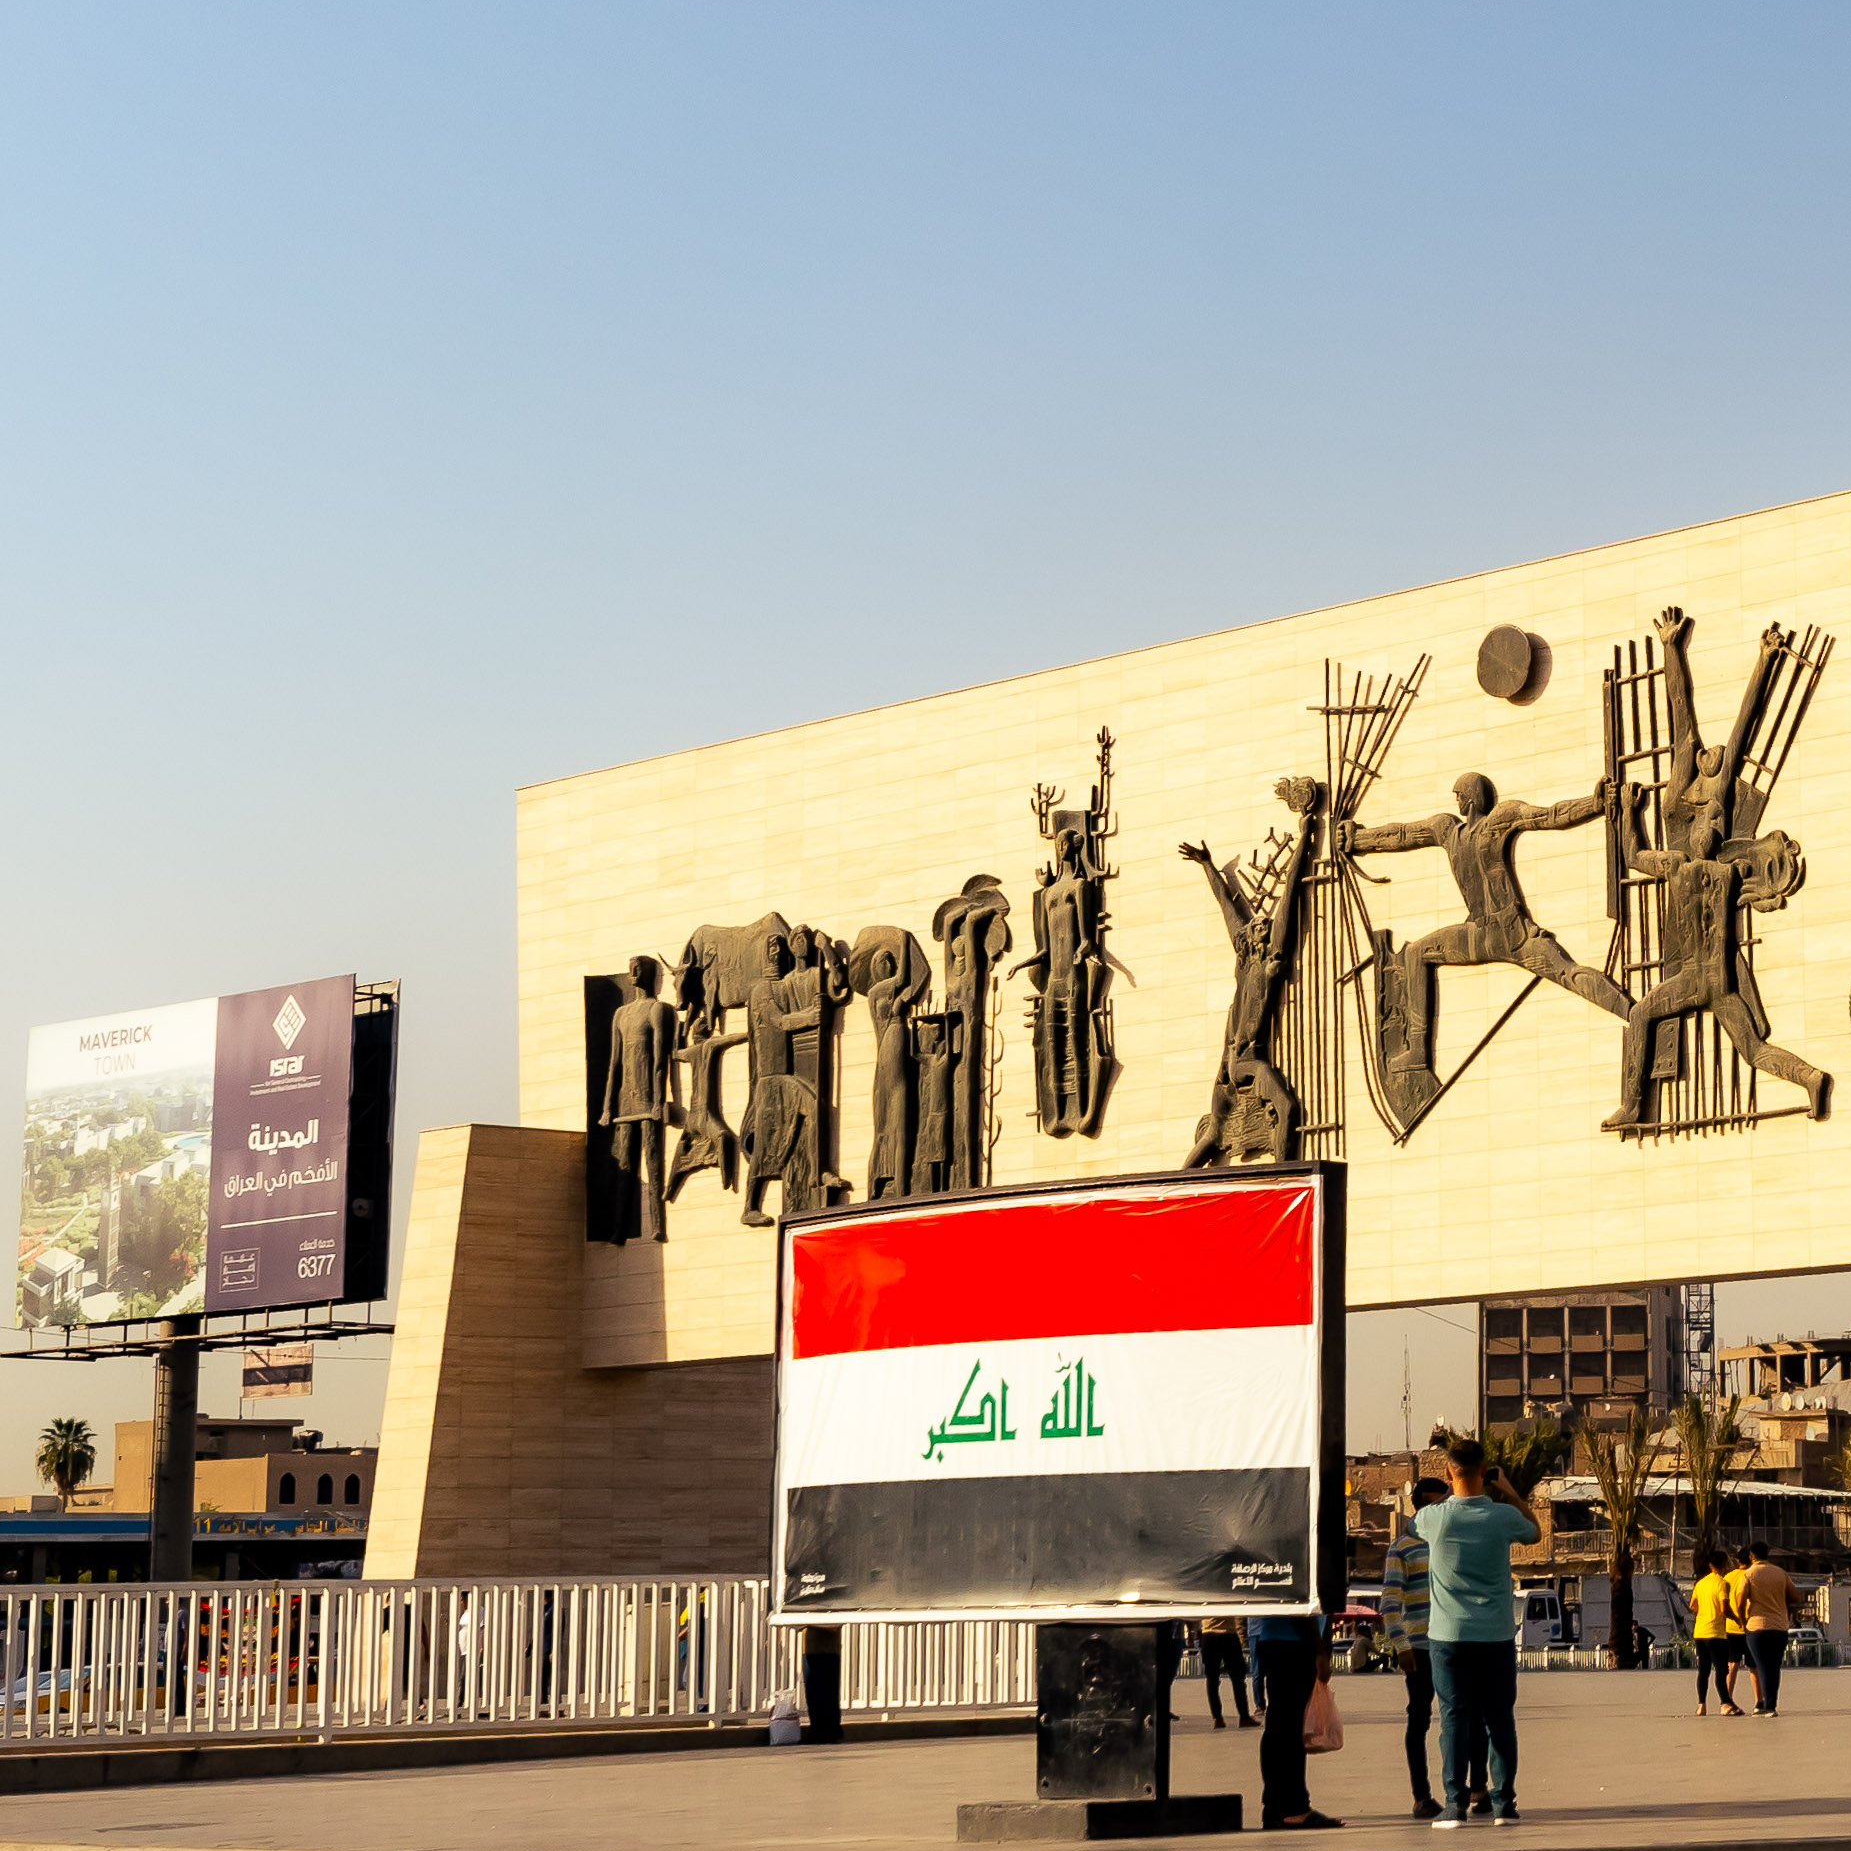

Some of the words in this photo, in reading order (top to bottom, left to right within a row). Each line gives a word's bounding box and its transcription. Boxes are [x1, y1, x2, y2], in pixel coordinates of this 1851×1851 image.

[80, 1024, 152, 1052] MAVERICK
[94, 1053, 136, 1076] TOWN
[248, 1119, 318, 1155] المدينة
[224, 1171, 263, 1198] العراق
[264, 1169, 287, 1196] في
[289, 1158, 338, 1189] الأفخم
[298, 1254, 336, 1278] 6377
